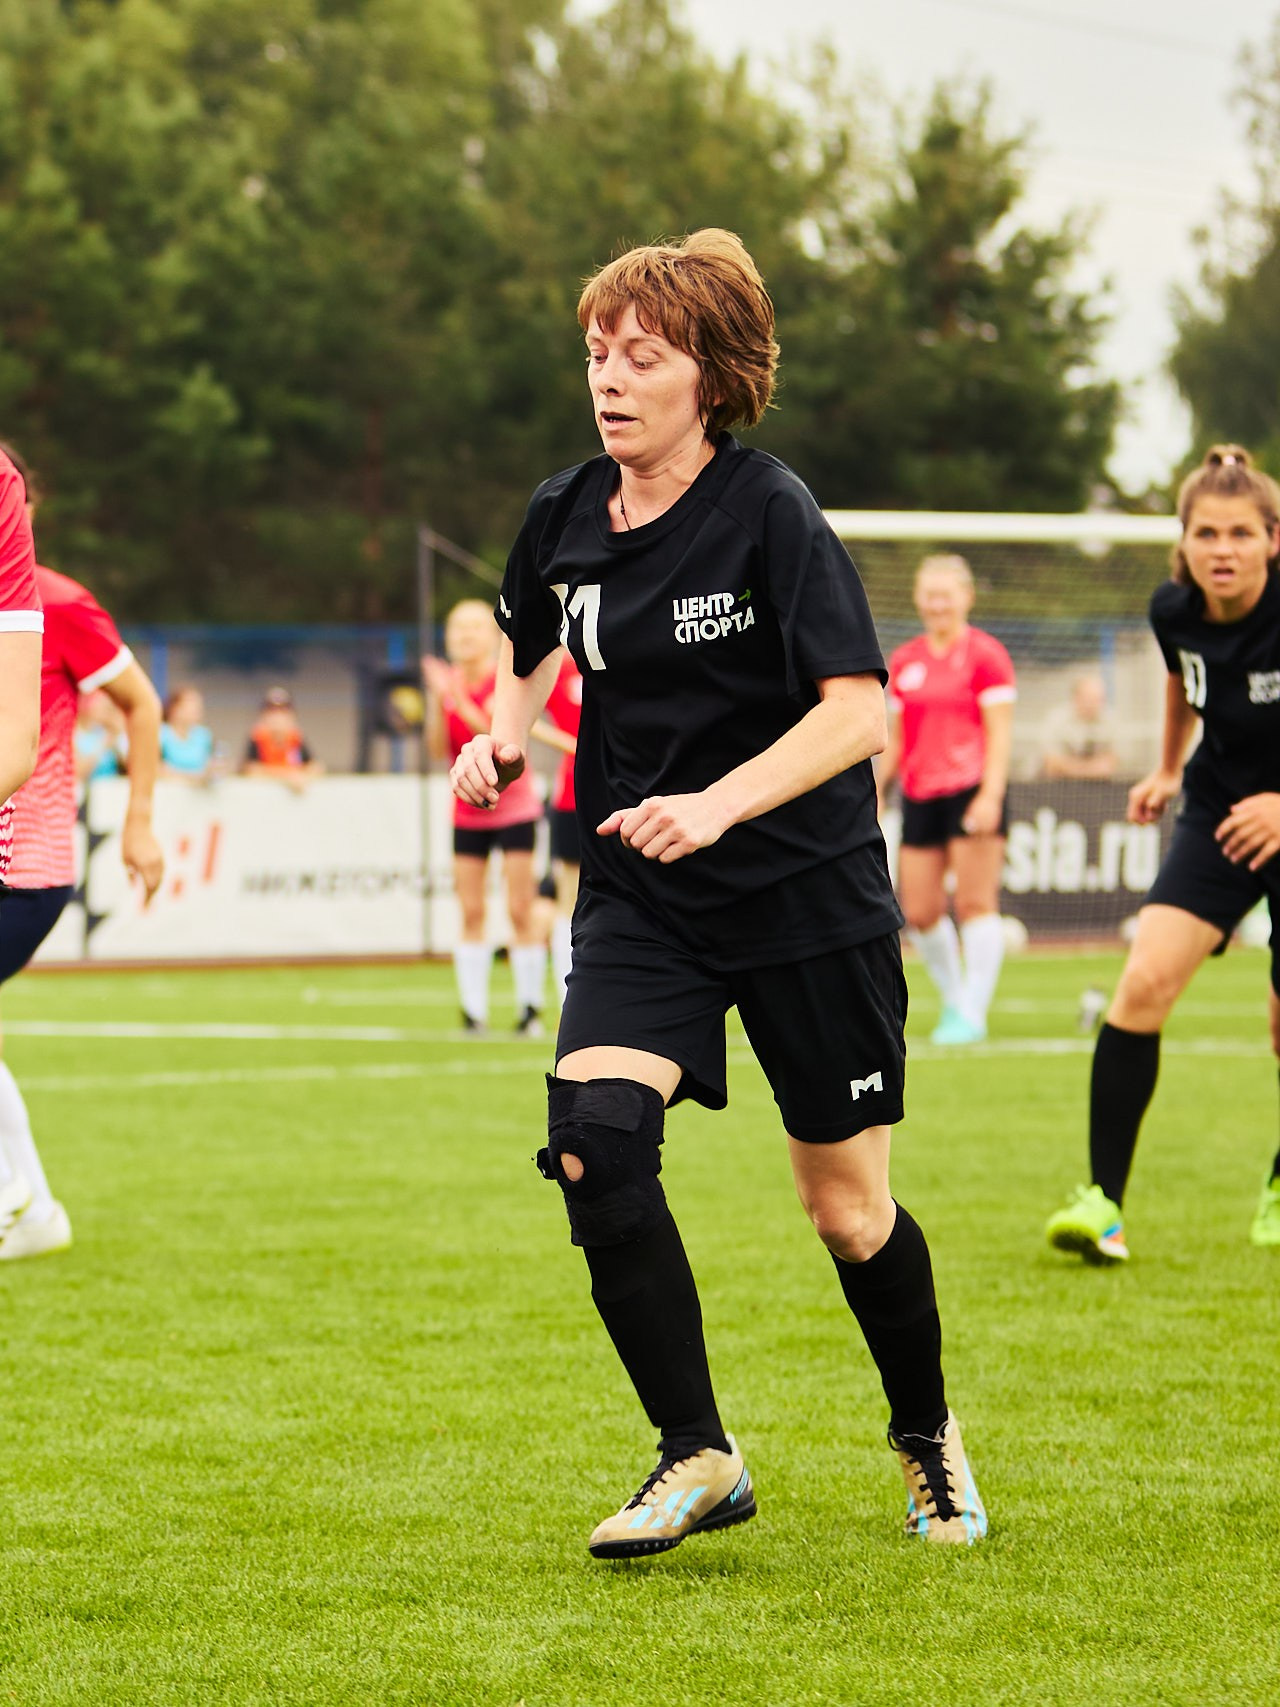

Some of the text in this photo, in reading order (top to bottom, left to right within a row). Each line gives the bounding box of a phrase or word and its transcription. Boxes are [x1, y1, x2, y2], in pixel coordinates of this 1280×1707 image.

[673, 592, 735, 622] ЦЕНТР
[674, 606, 756, 644] СПОРТА
[549, 583, 607, 671] 1
